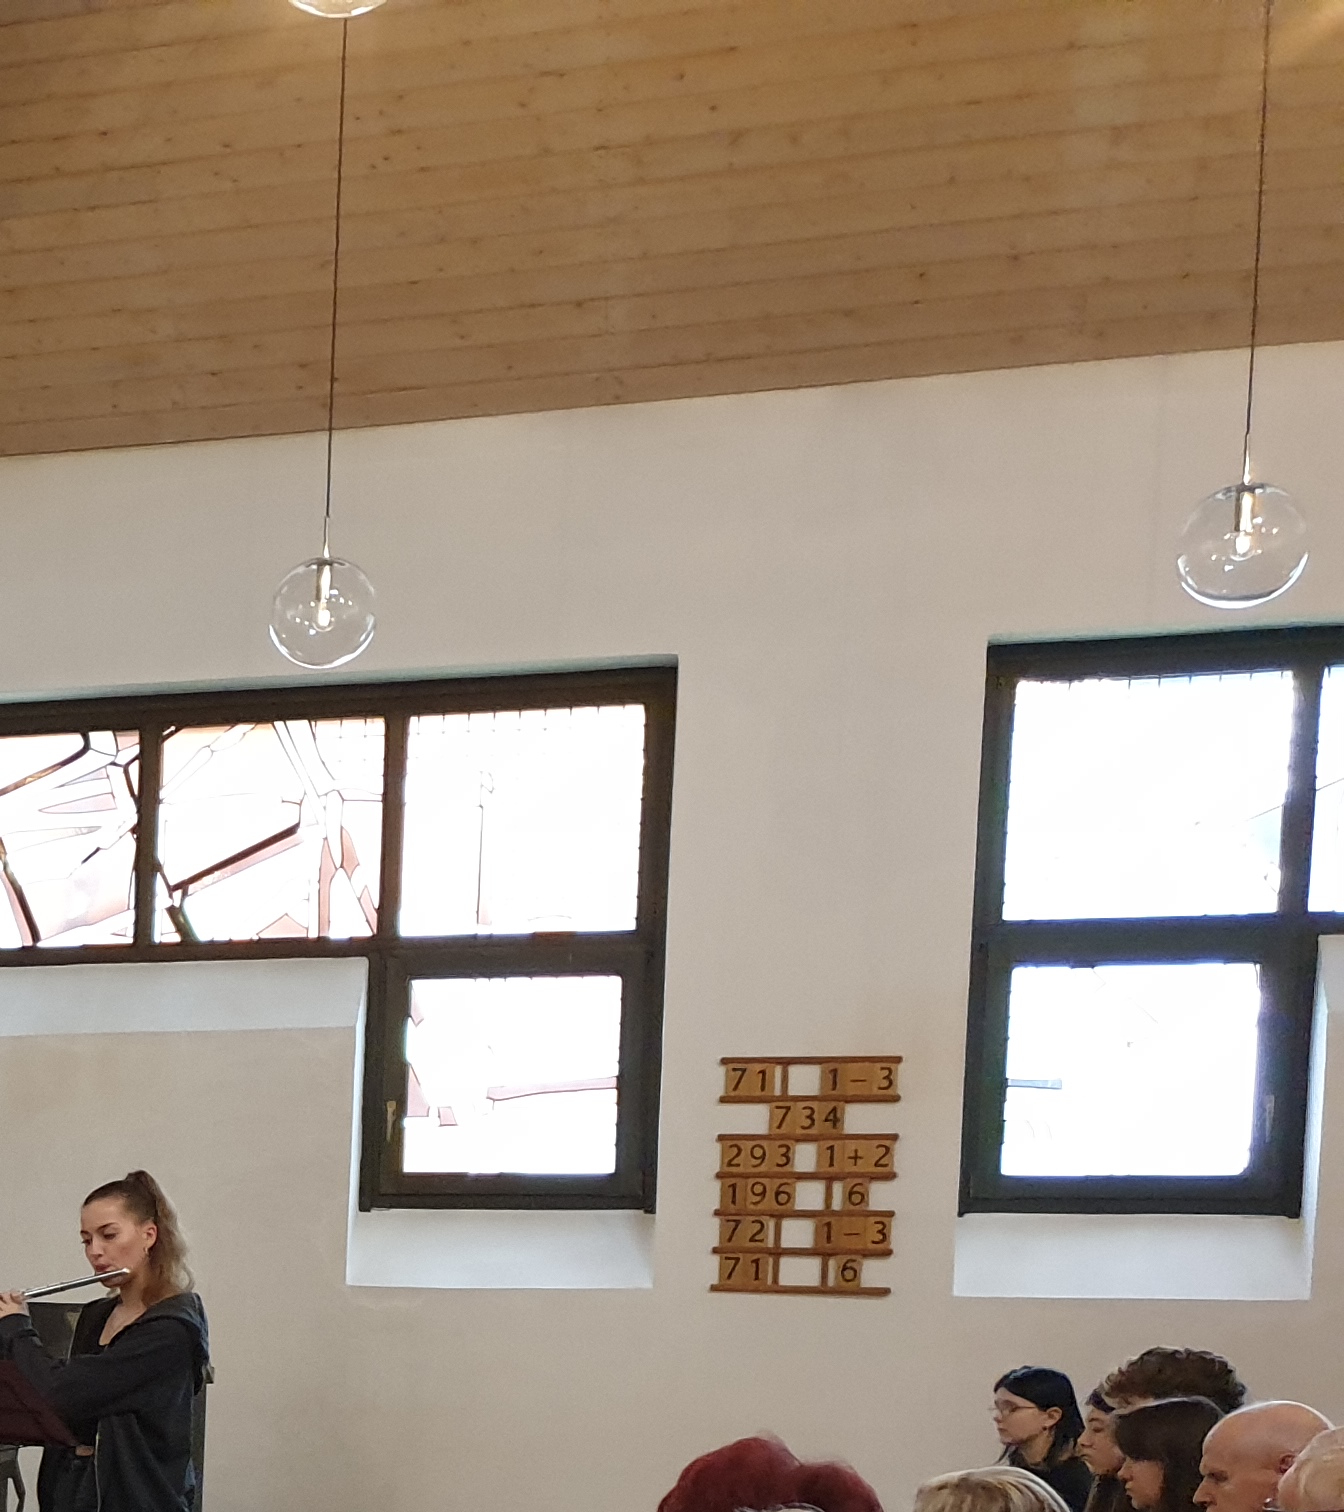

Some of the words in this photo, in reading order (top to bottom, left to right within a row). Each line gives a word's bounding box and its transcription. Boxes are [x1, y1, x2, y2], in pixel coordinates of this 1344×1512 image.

[730, 1067, 768, 1092] 71
[774, 1105, 841, 1130] 734
[726, 1143, 792, 1168] 293
[727, 1181, 792, 1206] 196
[847, 1182, 866, 1206] 6
[725, 1219, 766, 1243] 72
[724, 1256, 762, 1281] 71
[840, 1258, 858, 1283] 6
